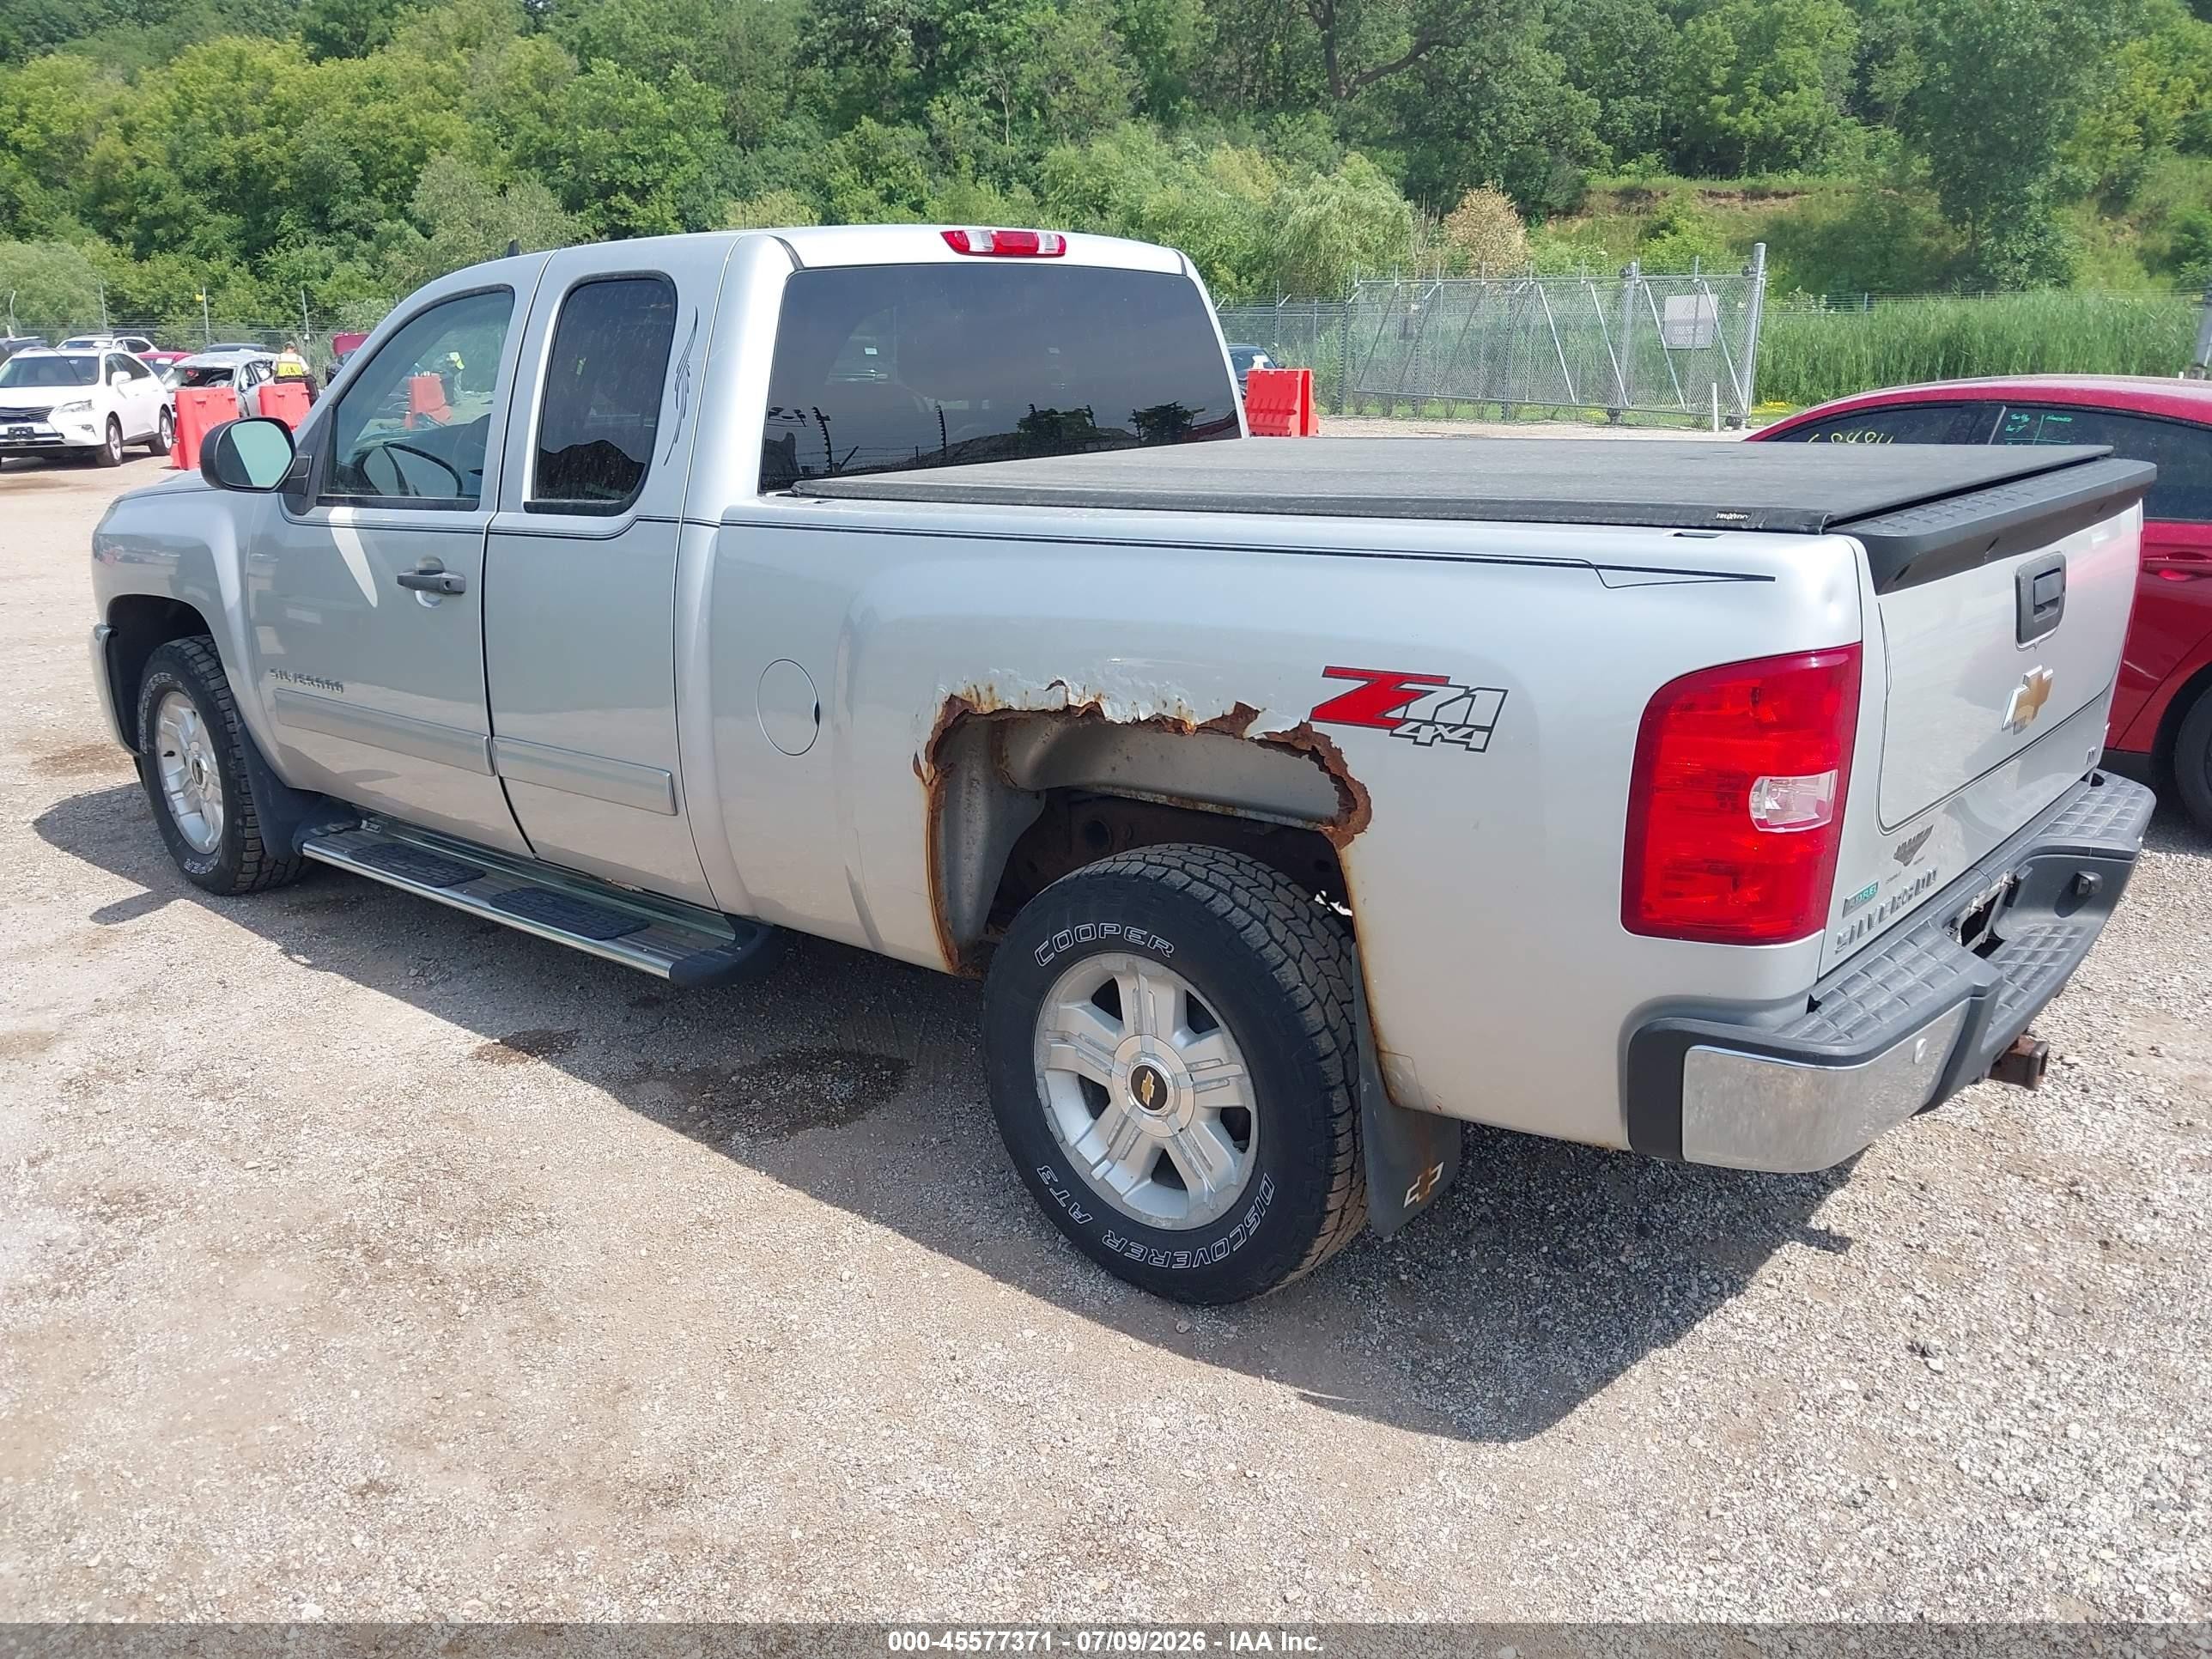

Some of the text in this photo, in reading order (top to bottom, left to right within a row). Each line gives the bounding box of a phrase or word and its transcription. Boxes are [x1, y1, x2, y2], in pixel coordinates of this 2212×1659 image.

[1309, 665, 1509, 730] Z71
[1034, 922, 1176, 967] COOPER
[1036, 1164, 1276, 1269] DISCOVERER AT3
